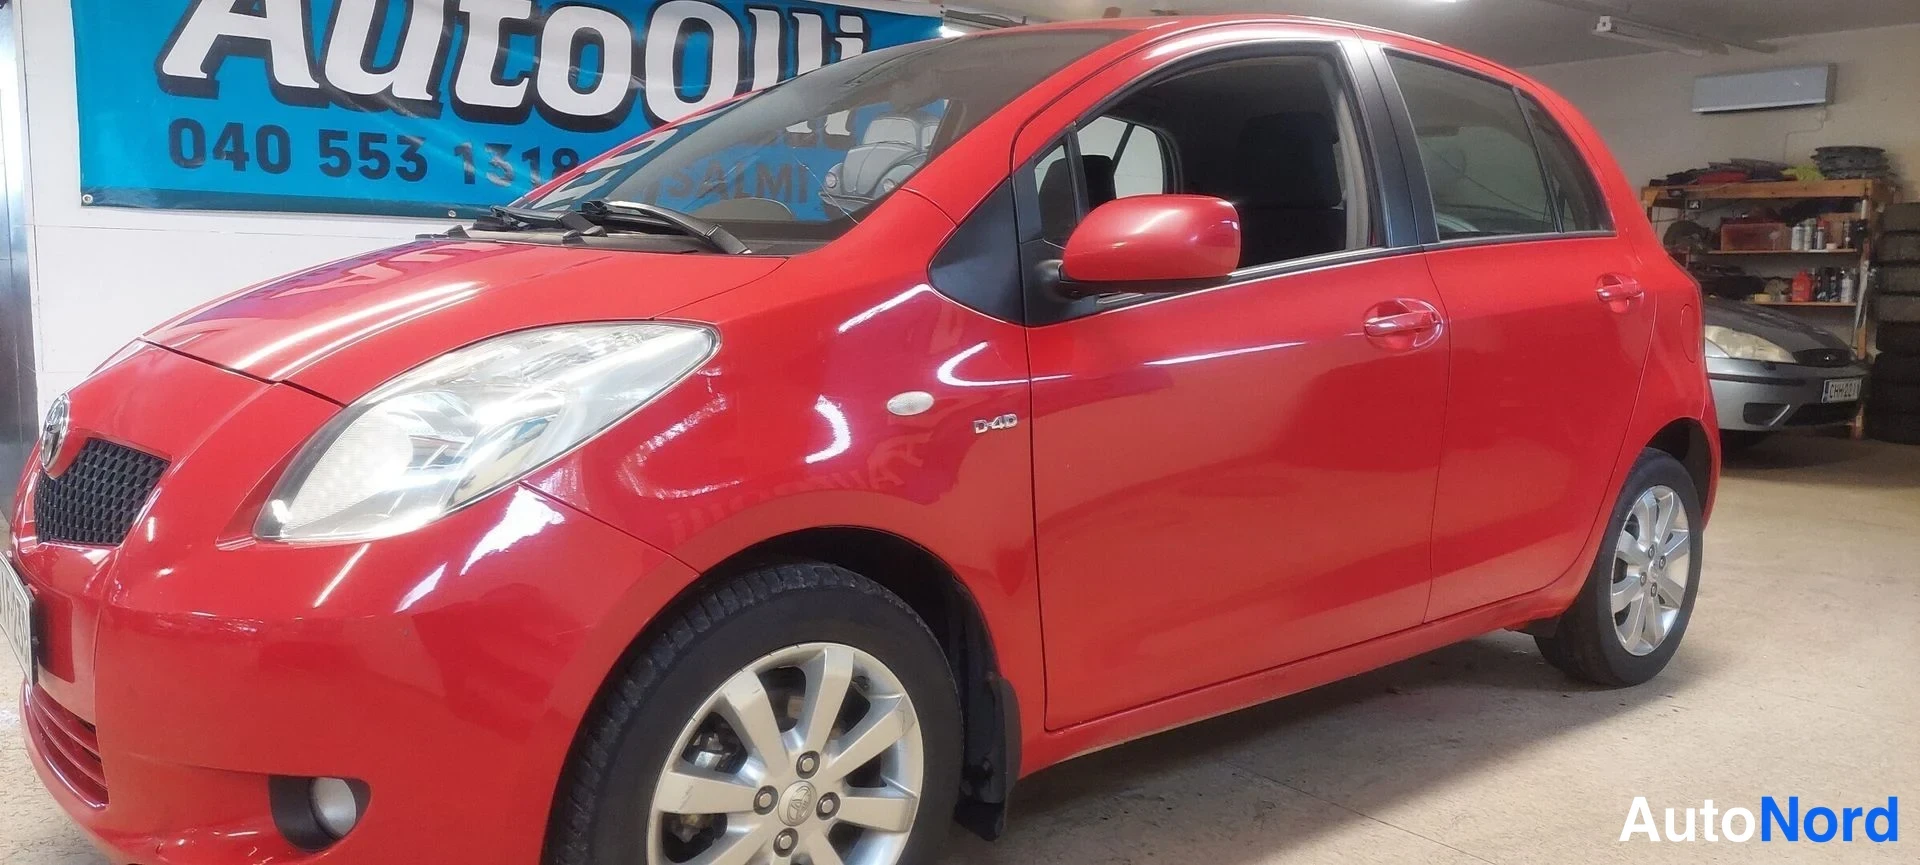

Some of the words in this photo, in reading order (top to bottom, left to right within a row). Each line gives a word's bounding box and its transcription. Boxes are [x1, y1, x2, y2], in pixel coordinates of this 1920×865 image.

[162, 0, 866, 136] AutoOlli
[168, 117, 292, 175] 040
[318, 129, 428, 183] 553
[974, 413, 1018, 434] D-4D
